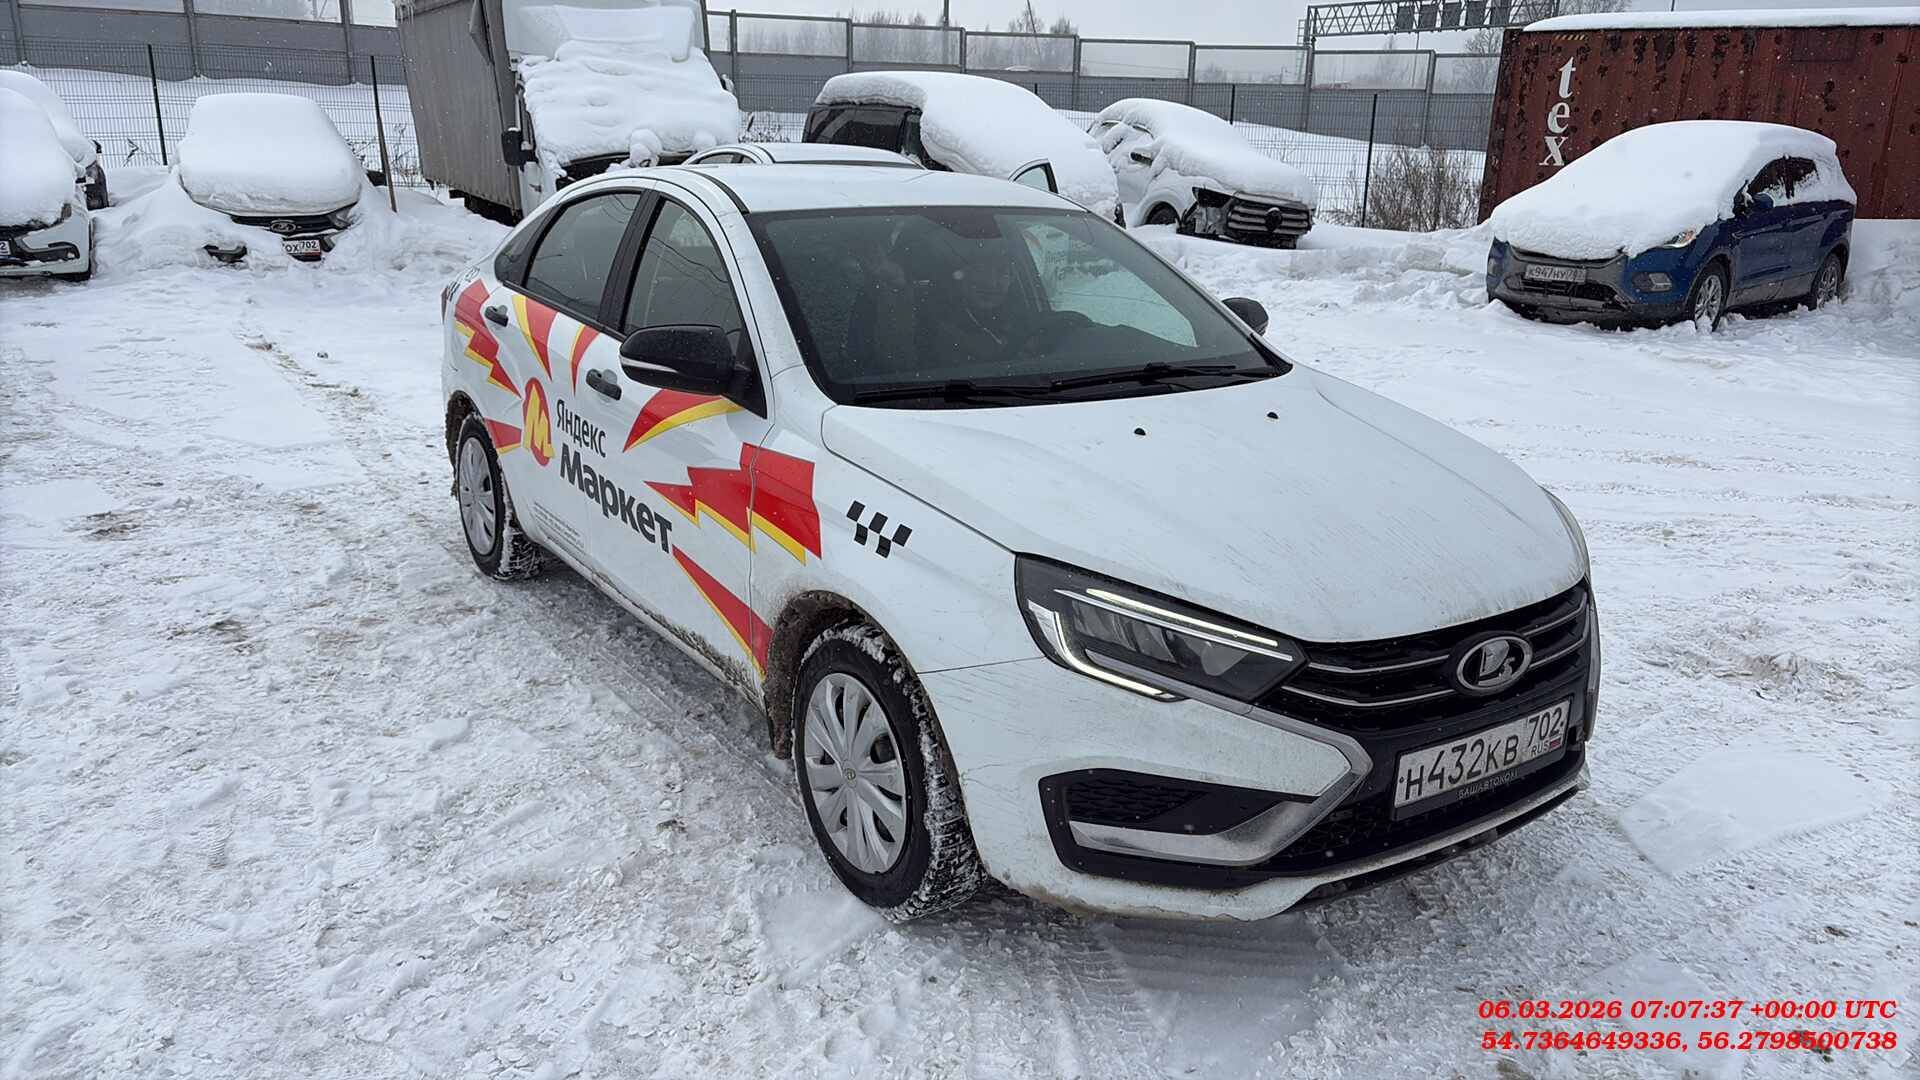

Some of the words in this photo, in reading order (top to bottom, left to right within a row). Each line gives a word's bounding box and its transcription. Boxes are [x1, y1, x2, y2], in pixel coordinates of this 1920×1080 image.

[1538, 56, 1577, 166] tex
[300, 241, 317, 249] 702
[556, 399, 607, 458] Яндекс
[559, 443, 673, 554] Маркет
[1405, 734, 1519, 801] Н432КВ
[1528, 706, 1563, 748] 702
[1531, 740, 1550, 757] RUS
